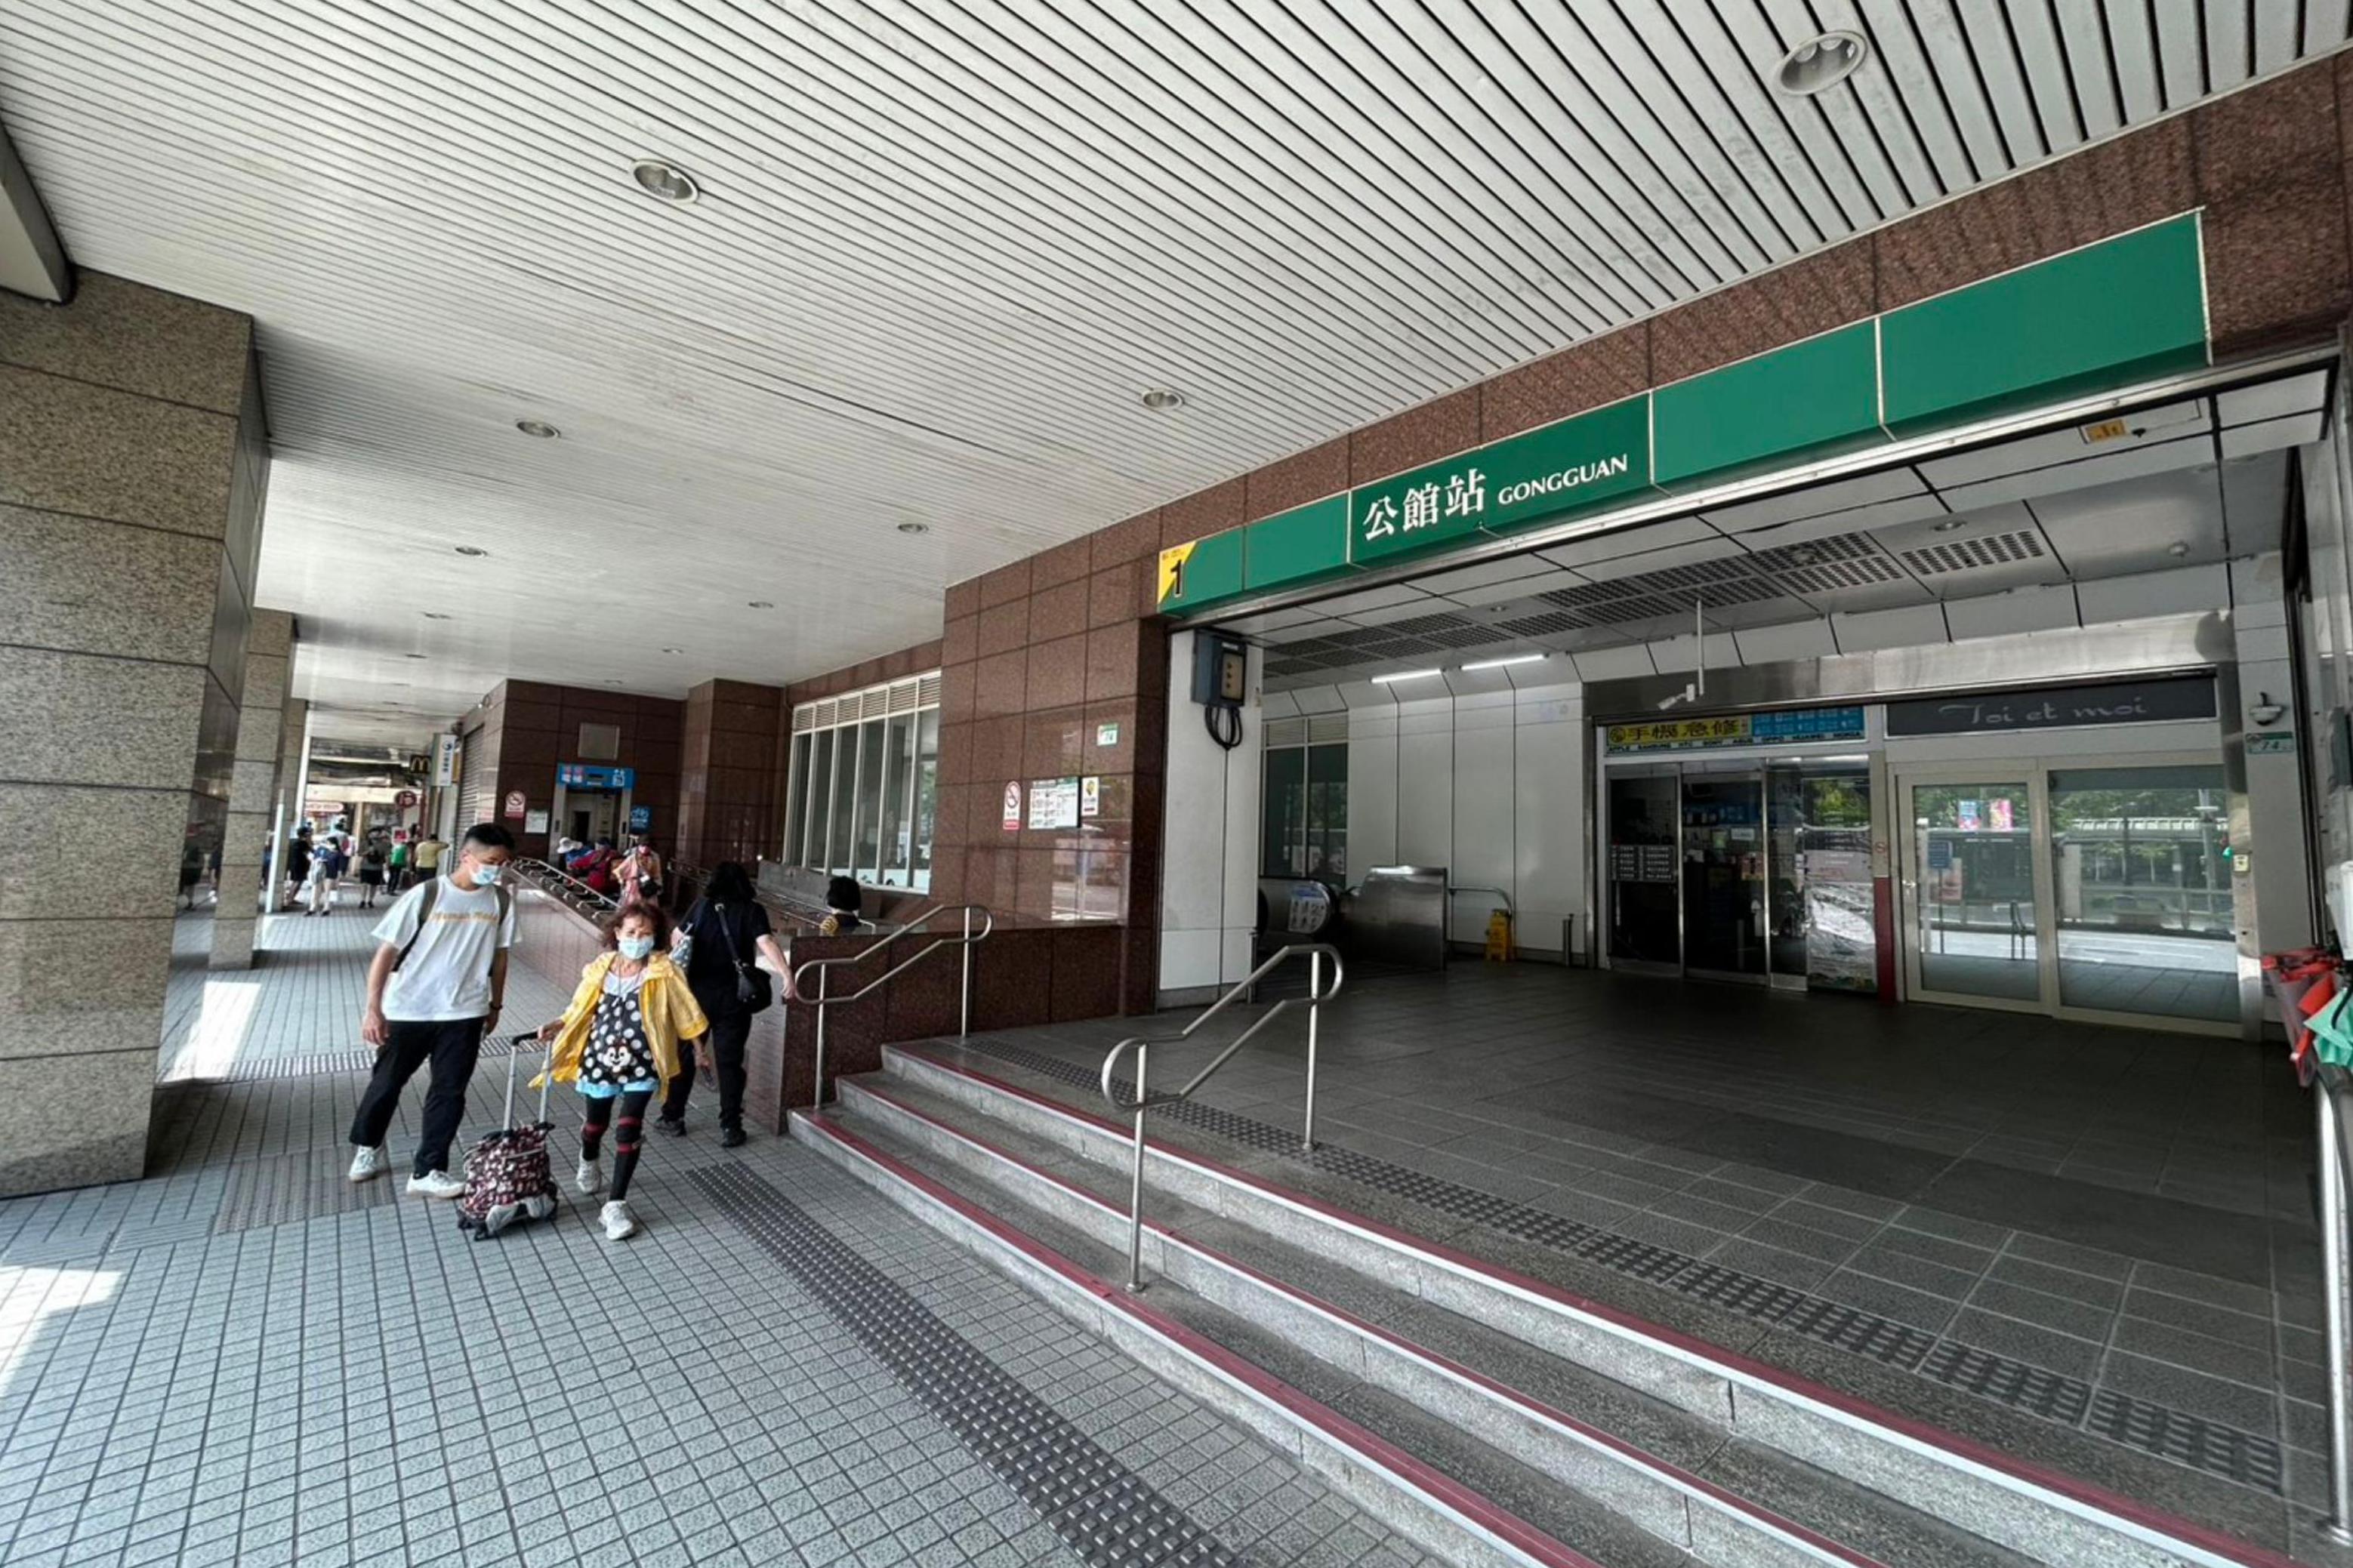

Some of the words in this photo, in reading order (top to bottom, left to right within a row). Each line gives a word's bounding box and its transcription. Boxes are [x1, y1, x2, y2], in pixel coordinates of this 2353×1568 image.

[1498, 453, 1629, 507] GONGGUAN
[1362, 467, 1487, 541] 公館站
[1170, 559, 1183, 596] 1
[1938, 703, 2014, 724] Toi
[2025, 701, 2058, 722] et
[2074, 696, 2148, 718] moi
